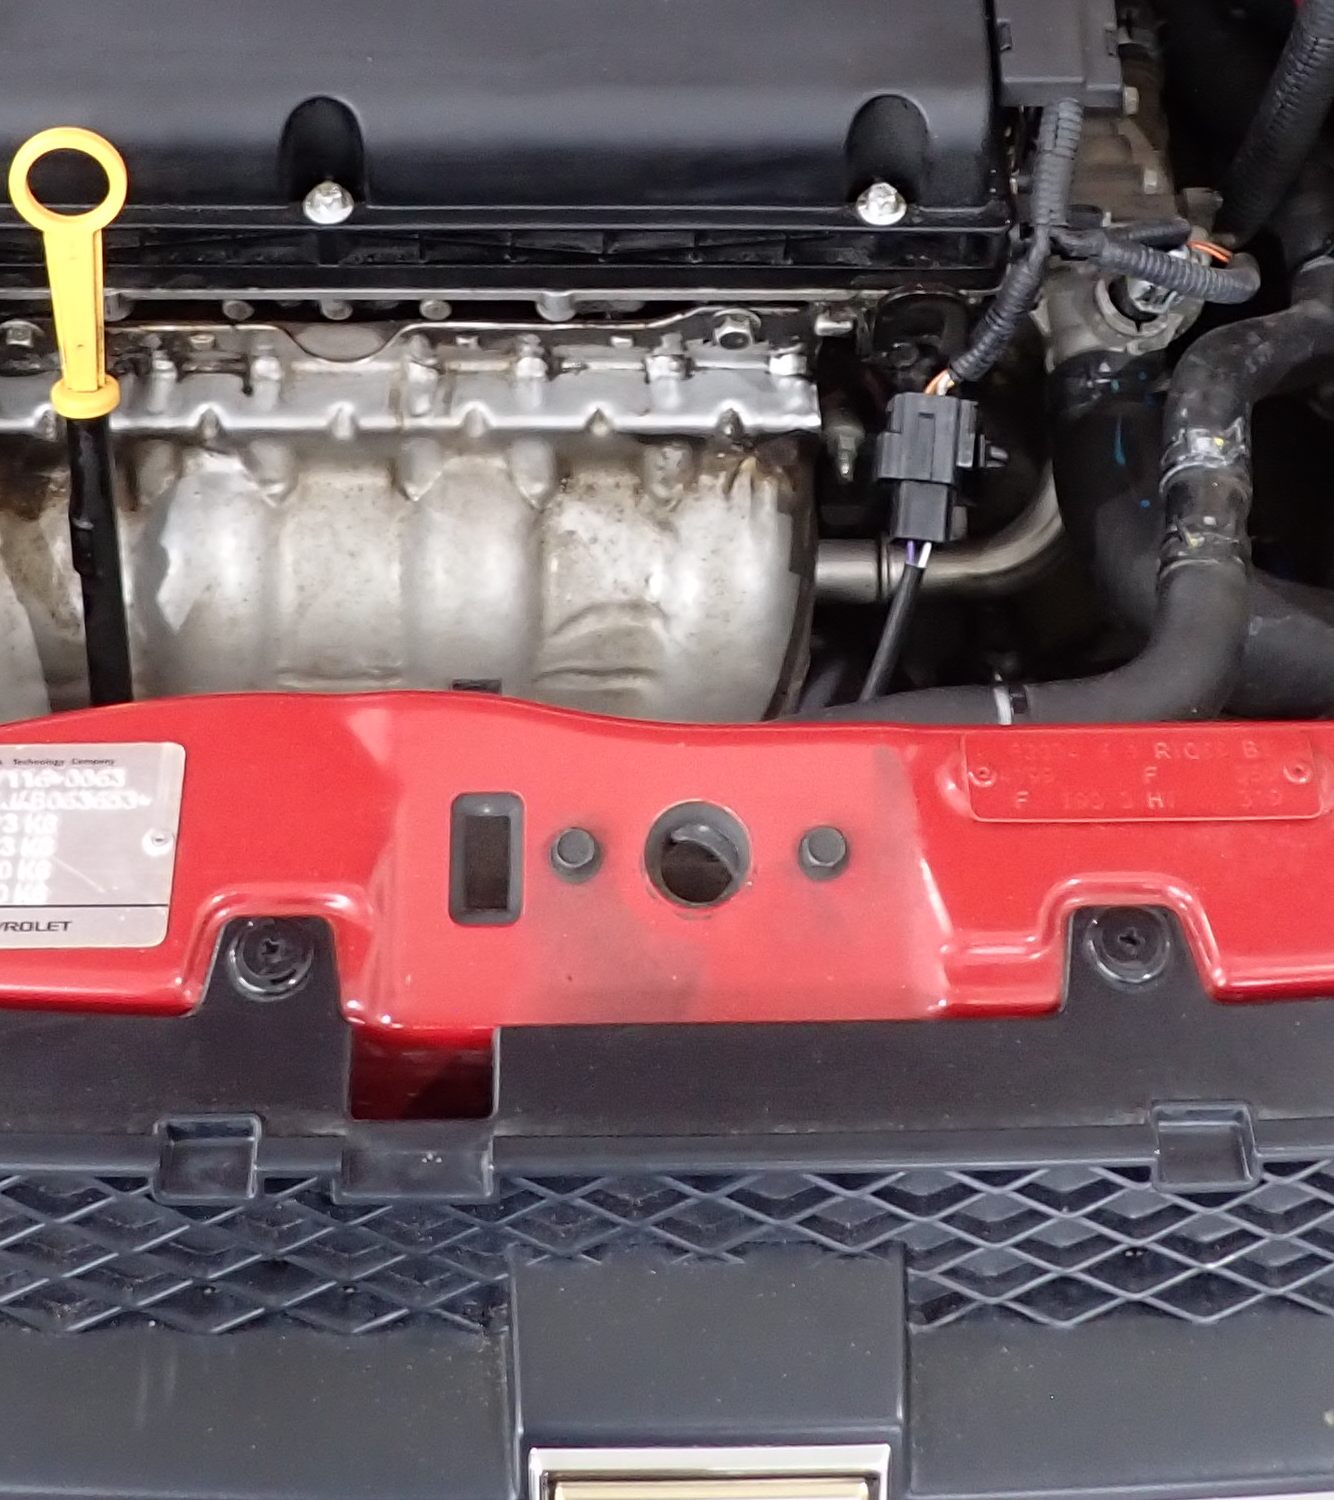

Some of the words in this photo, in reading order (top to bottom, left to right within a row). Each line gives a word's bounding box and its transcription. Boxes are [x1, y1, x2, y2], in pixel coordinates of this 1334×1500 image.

[23, 813, 59, 835] KG
[20, 836, 56, 858] KG
[17, 859, 52, 881] KG
[13, 883, 50, 905] KG
